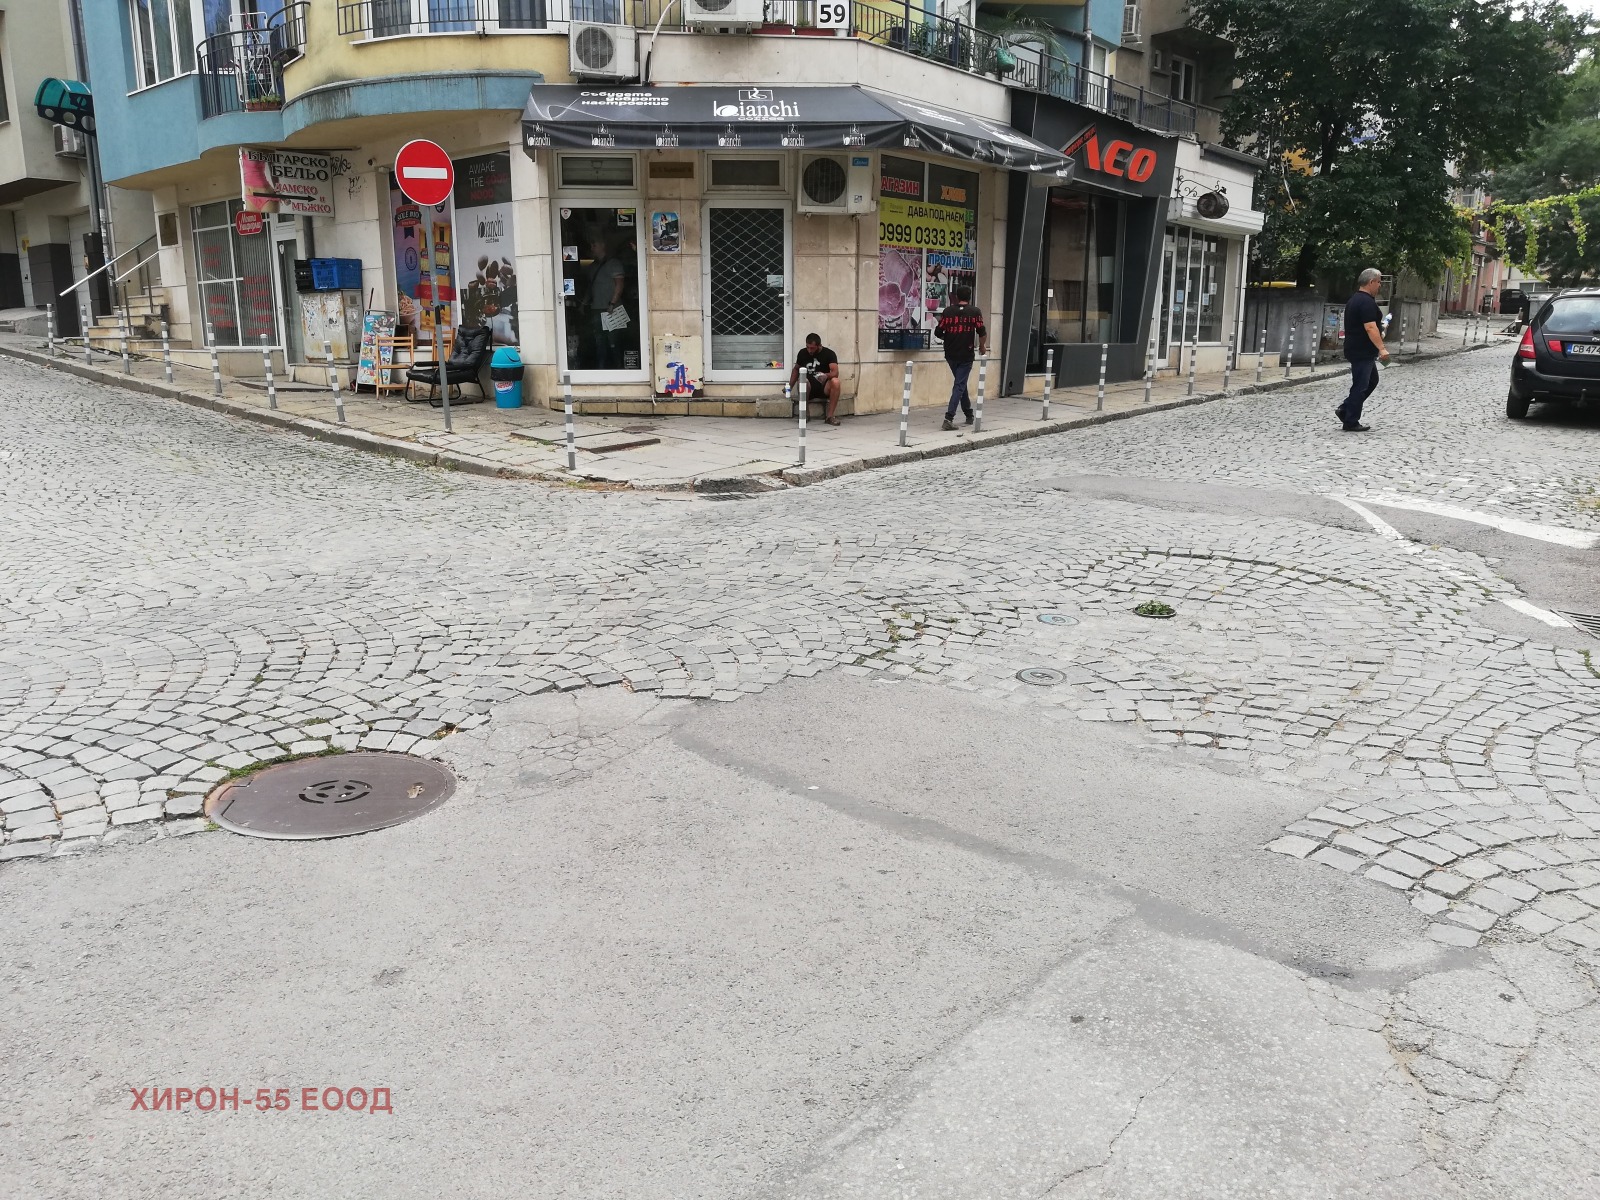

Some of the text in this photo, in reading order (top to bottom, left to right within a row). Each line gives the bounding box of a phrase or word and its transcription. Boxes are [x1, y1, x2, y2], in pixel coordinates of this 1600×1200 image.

[819, 4, 846, 24] 59
[713, 100, 800, 117] bianchi
[272, 165, 329, 182] БЕЛЬО
[469, 161, 496, 175] AWAKE
[274, 182, 318, 195] ДАМСКО
[469, 175, 485, 188] THE
[881, 176, 920, 196] АГАЗИН
[291, 202, 332, 213] МЪЖКО
[907, 205, 928, 219] ДАВА
[928, 208, 945, 222] ПОД
[945, 210, 965, 223] НАЕМ
[880, 222, 912, 243] 0999
[915, 226, 946, 247] 0333
[948, 230, 963, 248] 33
[929, 253, 974, 269] ПРОДУКТИ
